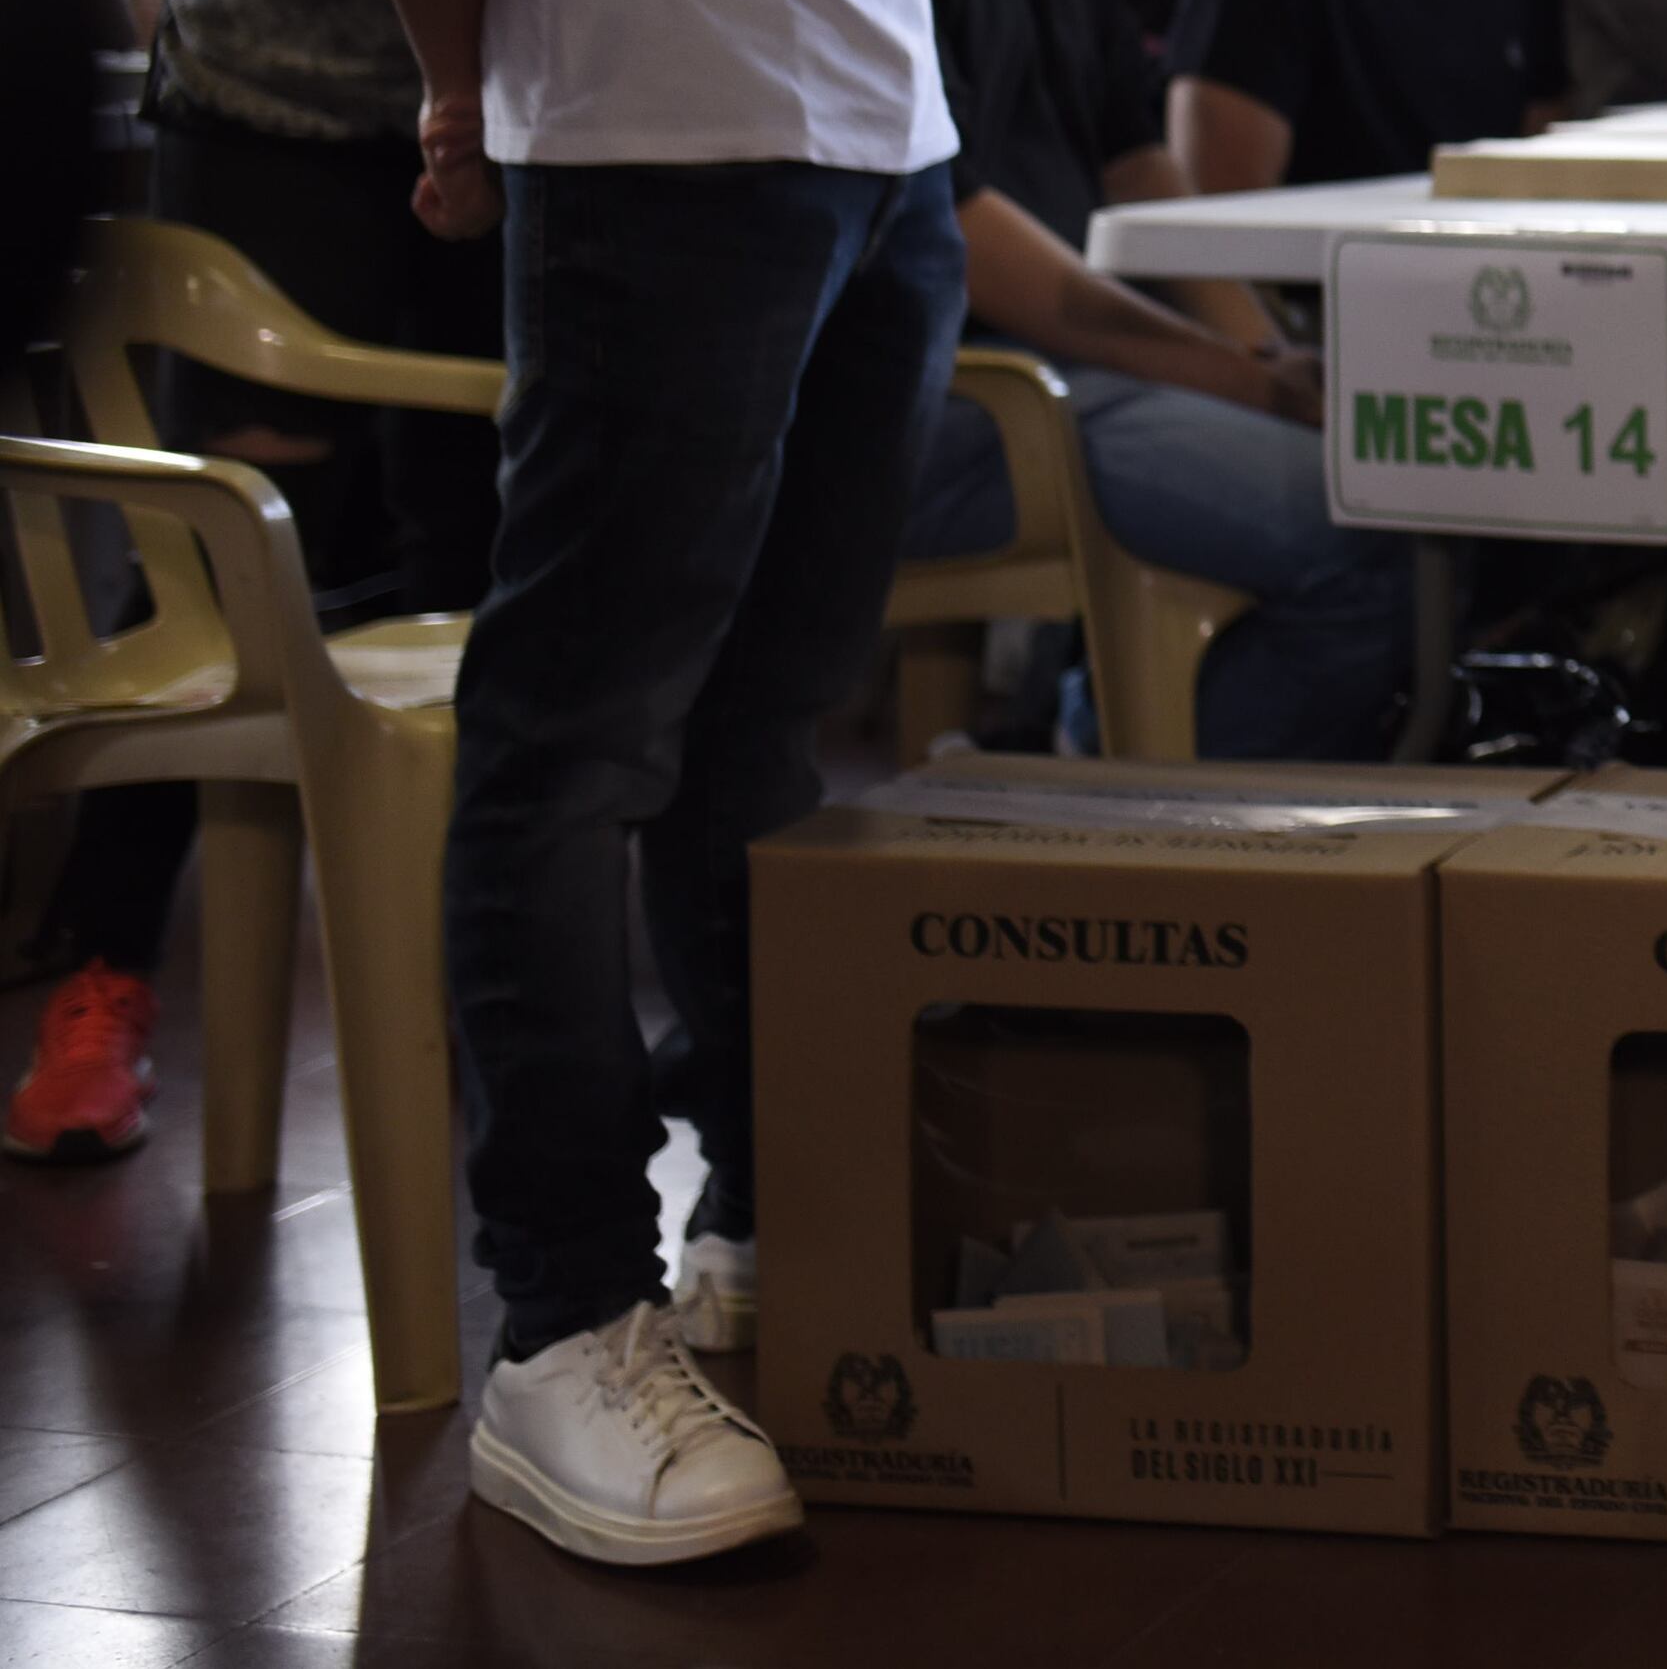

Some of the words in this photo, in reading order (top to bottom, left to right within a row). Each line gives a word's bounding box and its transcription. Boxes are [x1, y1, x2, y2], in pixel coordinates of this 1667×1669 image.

[1353, 391, 1535, 471] MESA
[1563, 403, 1656, 476] 14
[910, 911, 1249, 967] CONSULTAS
